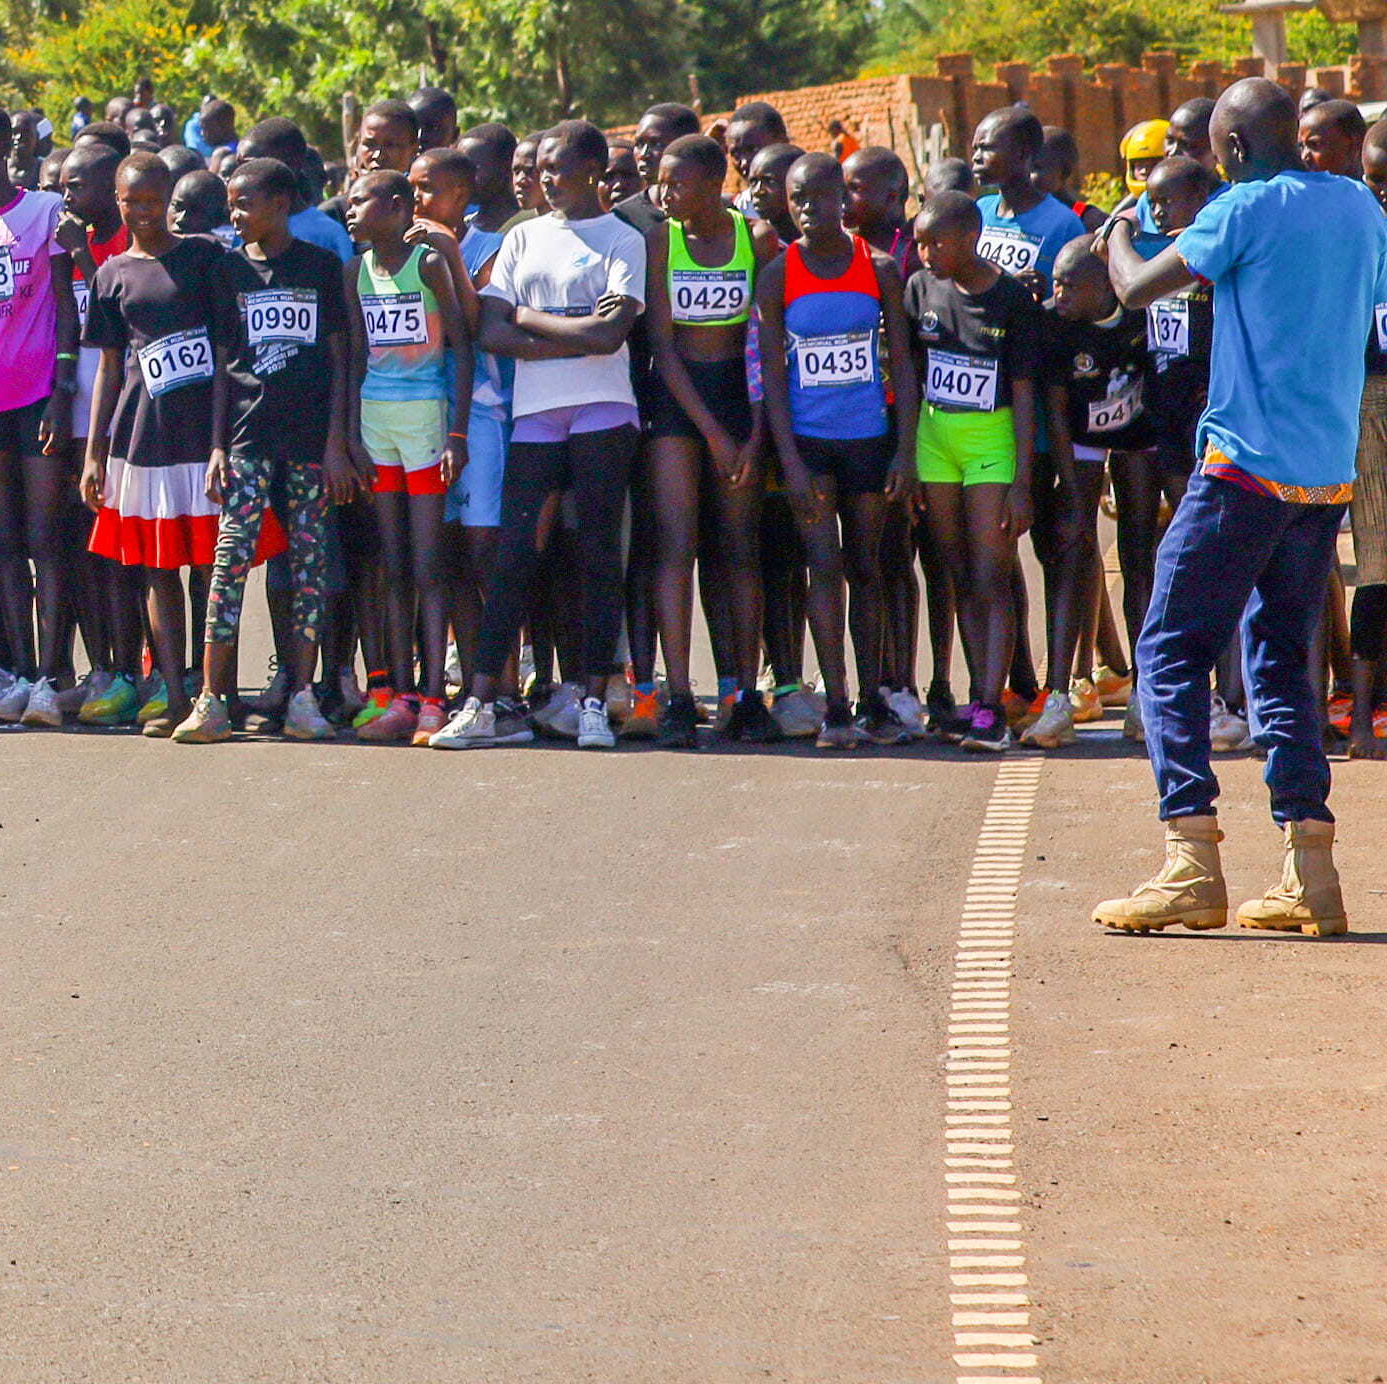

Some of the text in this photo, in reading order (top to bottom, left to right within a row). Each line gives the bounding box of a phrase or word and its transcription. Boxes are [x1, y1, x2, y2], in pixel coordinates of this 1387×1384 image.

[14, 260, 31, 274] UF
[980, 241, 1031, 270] 0439
[677, 286, 744, 309] 0429
[251, 306, 311, 331] 0990
[366, 308, 420, 334] 0475
[1161, 317, 1182, 342] 37
[148, 342, 208, 379] 0162
[805, 347, 867, 375] 0435
[932, 366, 990, 398] 0407
